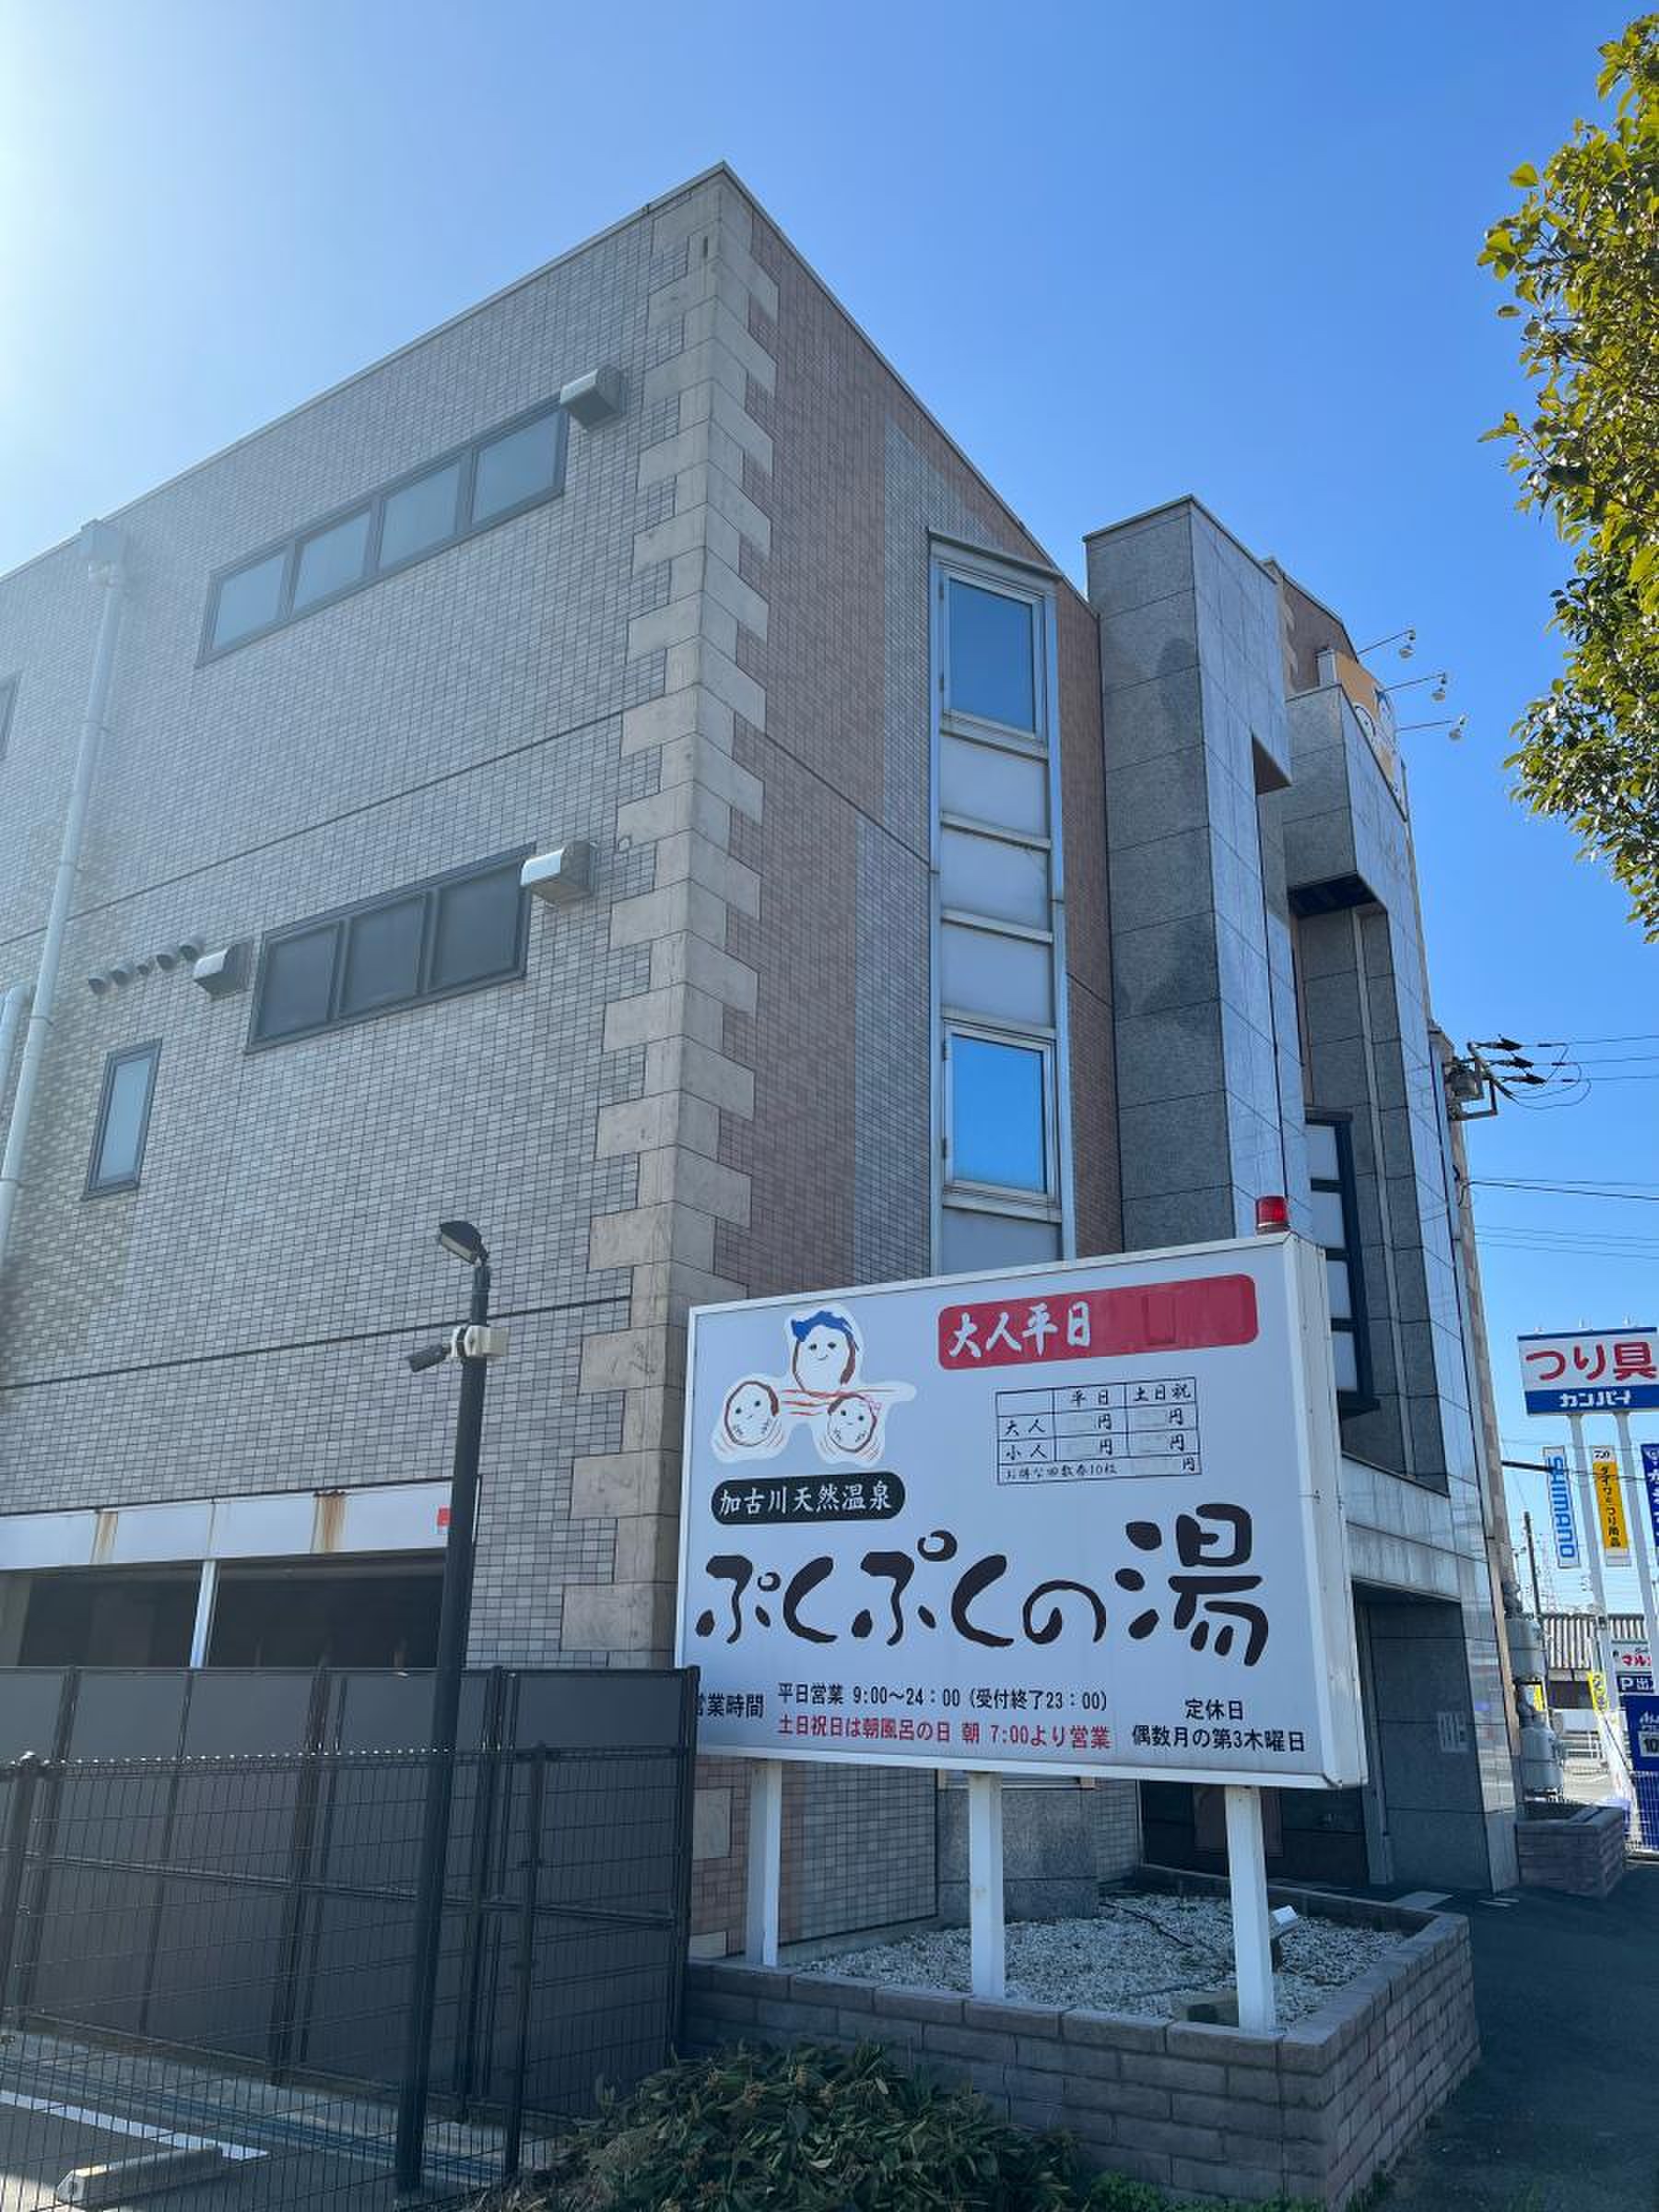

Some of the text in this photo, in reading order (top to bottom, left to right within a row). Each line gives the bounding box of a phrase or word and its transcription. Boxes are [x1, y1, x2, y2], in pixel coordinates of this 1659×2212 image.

[948, 1300, 1092, 1358] 大人平日
[1525, 1341, 1657, 1382] つり具
[1072, 1389, 1110, 1407] 平日
[1005, 1407, 1183, 1436] 大人 円 円
[1006, 1433, 1185, 1461] 小人 円 円
[1182, 1457, 1196, 1472] 円
[719, 1479, 892, 1516] 加古川天然温泉
[695, 1503, 1269, 1667] ぷくぷくの湯
[778, 1682, 843, 1705] 平日営業
[1184, 1699, 1244, 1721] 定休日
[778, 1713, 951, 1742] 土日祝日は朝風呂の日
[962, 1723, 980, 1745] 朝
[1132, 1724, 1306, 1752] 偶数月の第3木曜日
